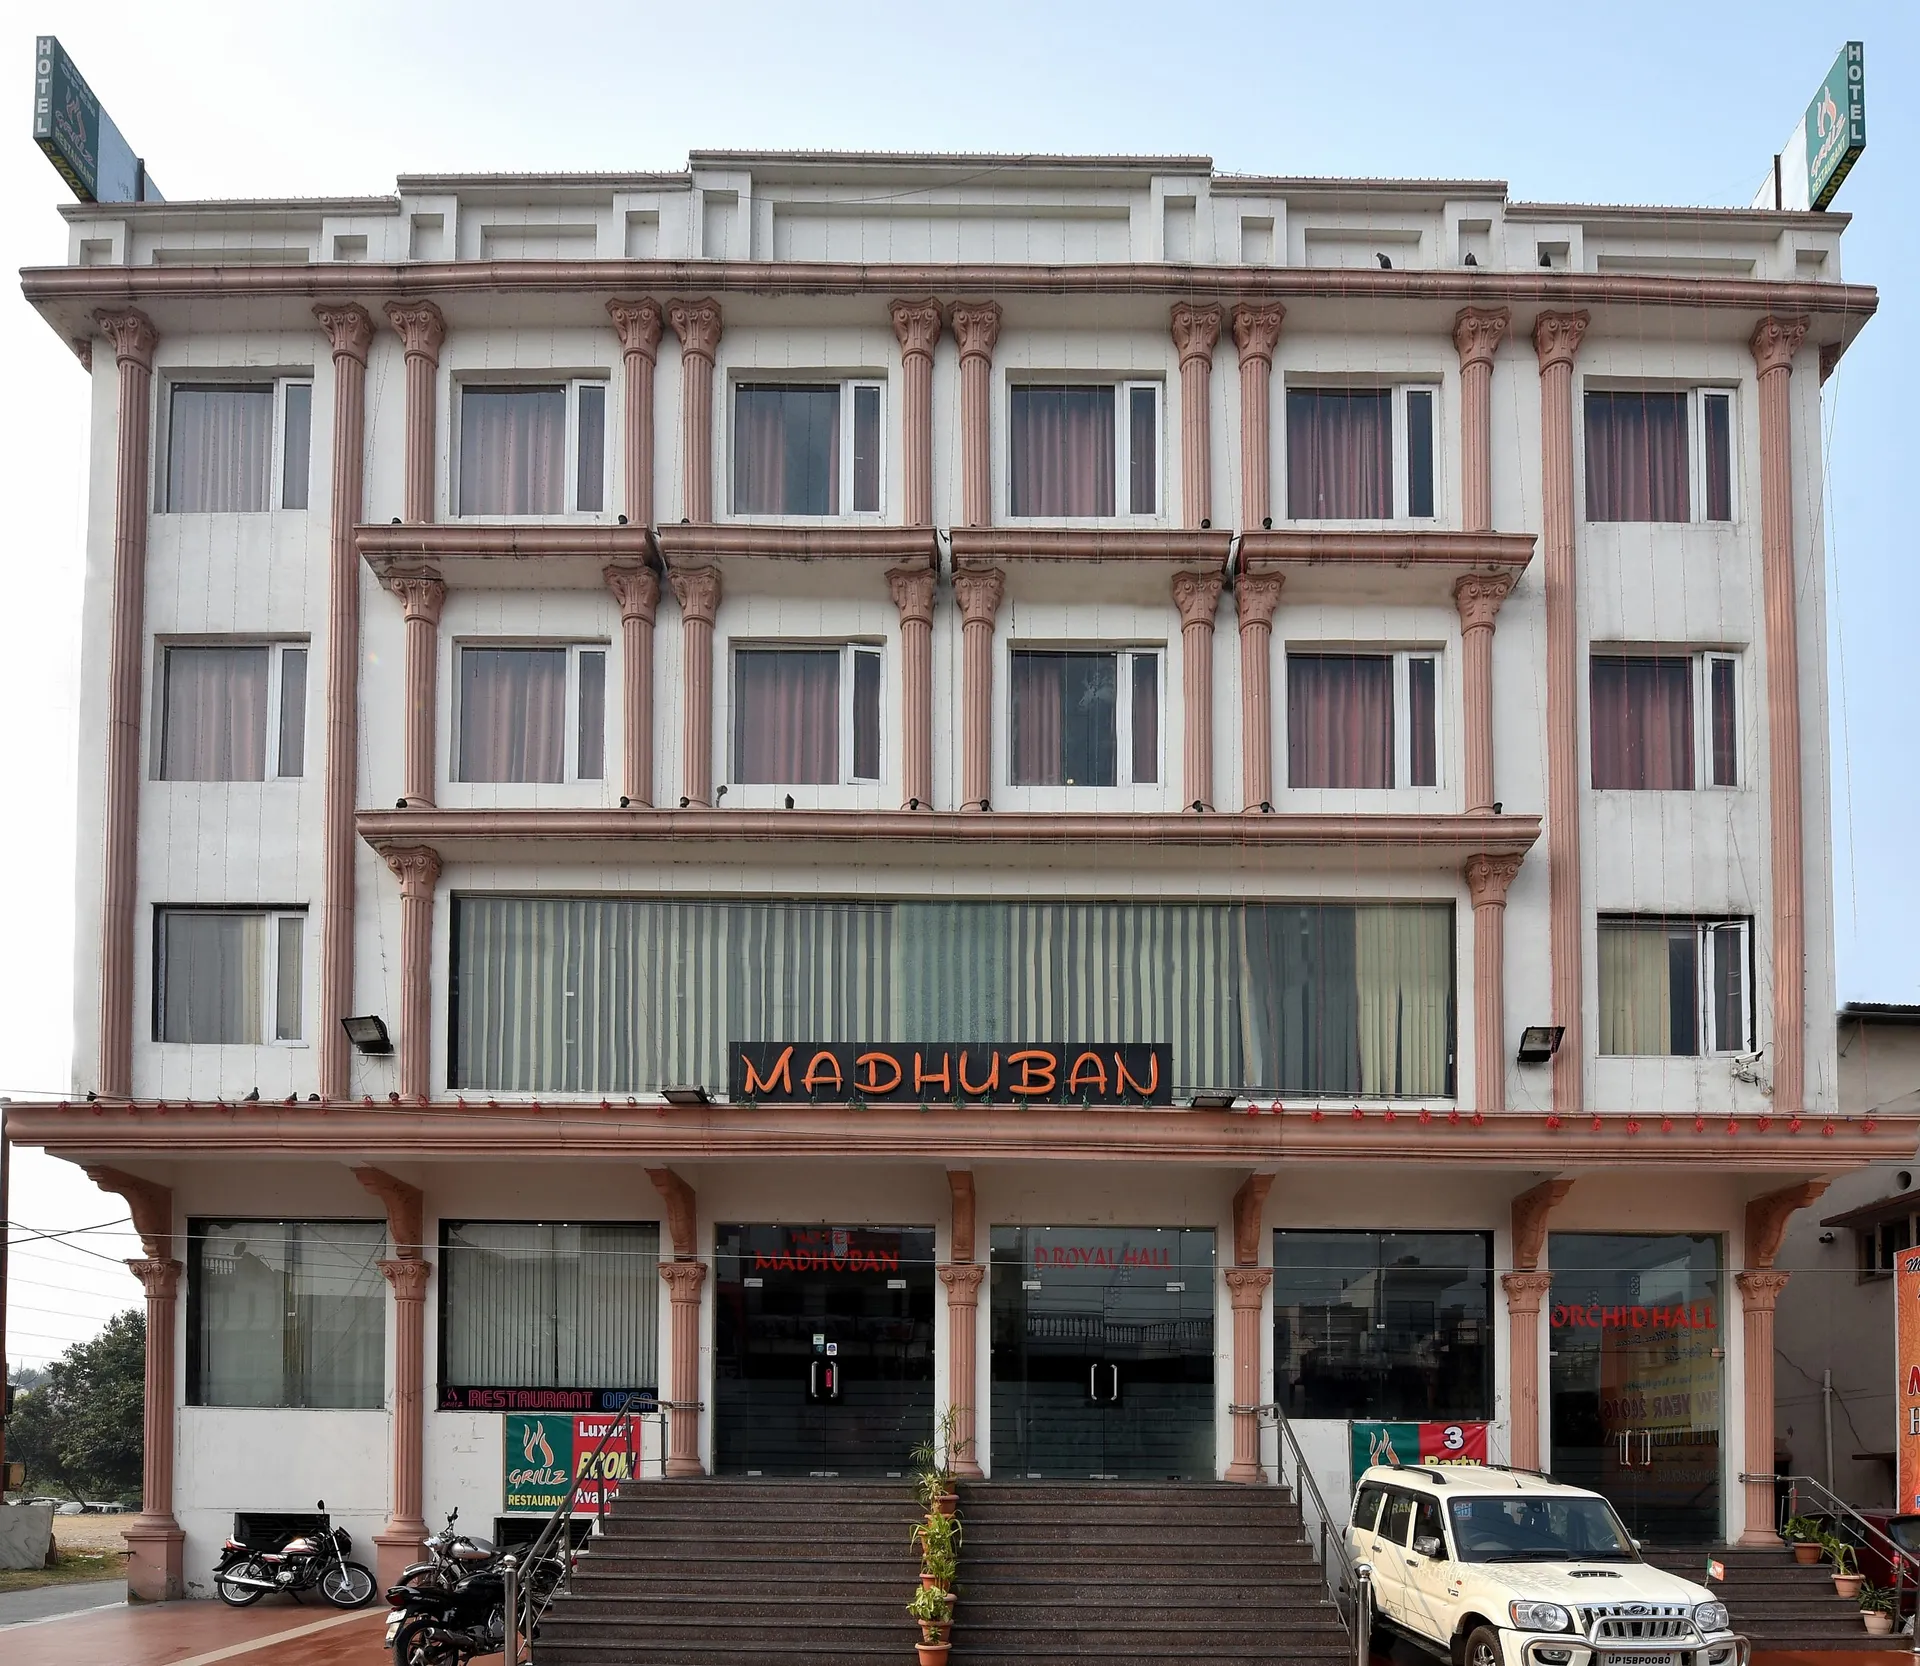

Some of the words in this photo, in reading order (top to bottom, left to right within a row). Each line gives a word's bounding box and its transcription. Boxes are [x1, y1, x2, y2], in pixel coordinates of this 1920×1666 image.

[37, 40, 52, 133] HOTEL
[1848, 45, 1862, 140] HOTEL
[55, 128, 96, 186] RESTAURANT
[1812, 134, 1846, 197] RESTAURANT
[742, 1046, 1158, 1096] MADHUBAN
[792, 1231, 856, 1245] HOTEL
[755, 1249, 900, 1272] MADHUBAN
[1124, 1248, 1174, 1270] HALL
[1550, 1304, 1648, 1328] ORCHID
[1653, 1304, 1718, 1329] HALL
[468, 1390, 593, 1408] RESTAURANT
[602, 1392, 653, 1409] OPEN
[1444, 1426, 1464, 1450] 3
[508, 1468, 568, 1488] GRILLZ
[508, 1494, 566, 1506] RESTAURAN
[1608, 1656, 1670, 1665] UP15BP0080
